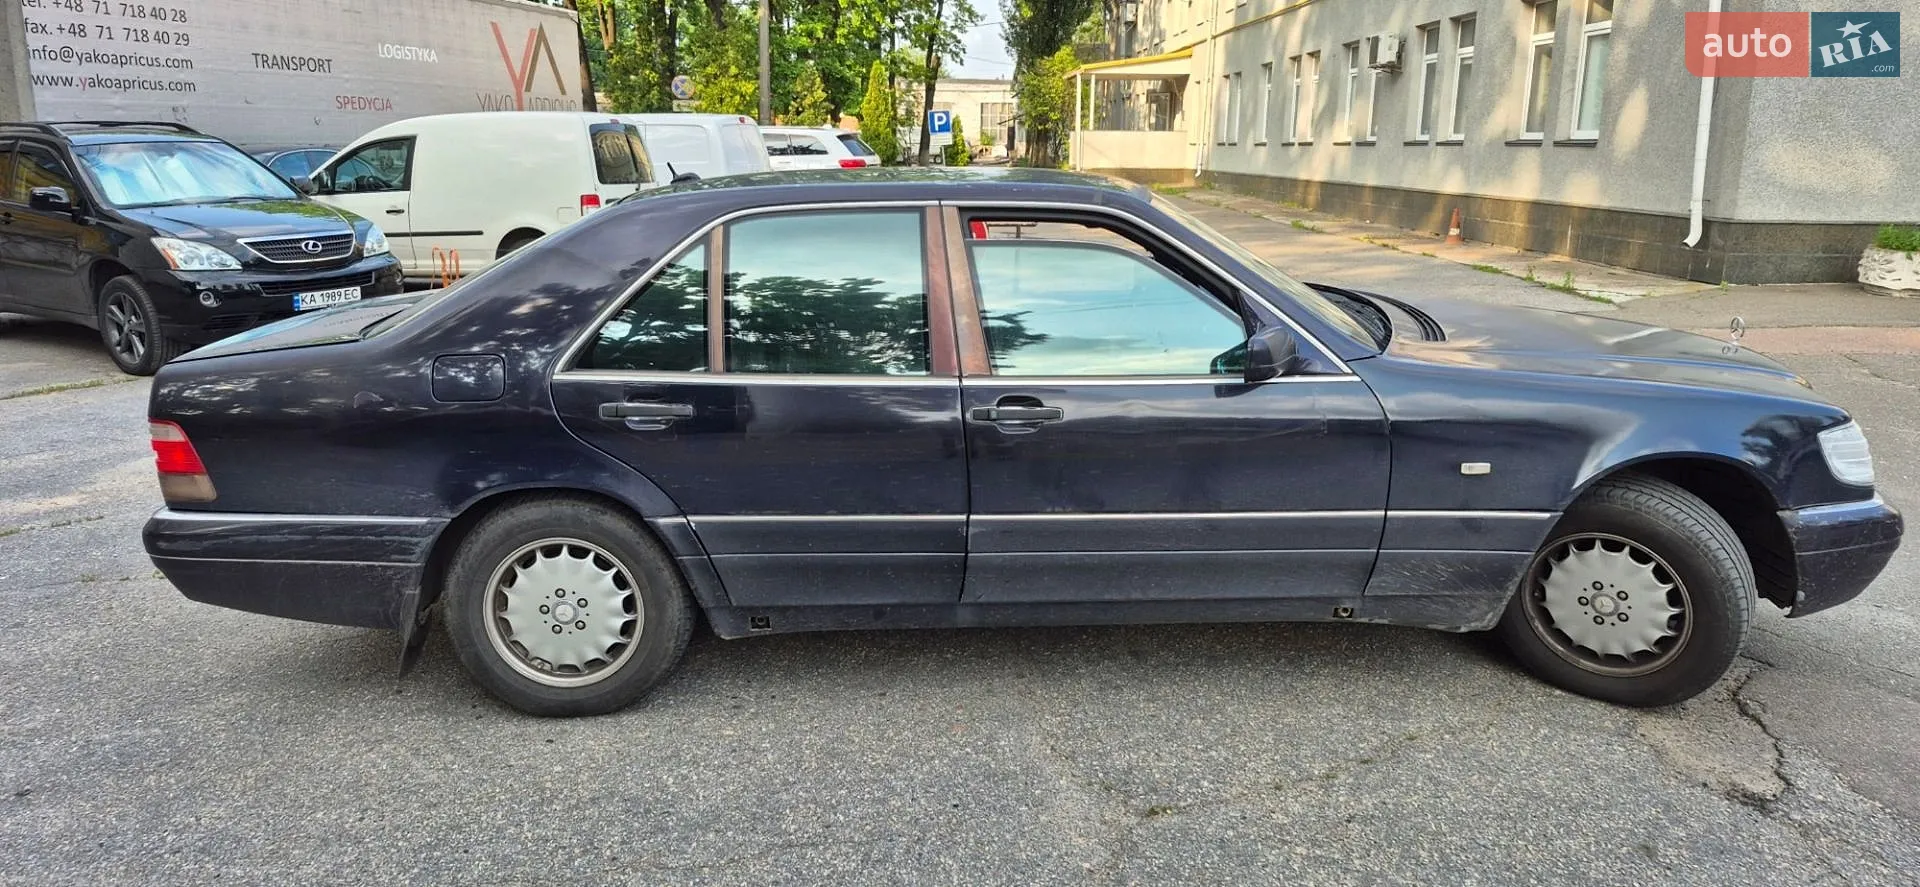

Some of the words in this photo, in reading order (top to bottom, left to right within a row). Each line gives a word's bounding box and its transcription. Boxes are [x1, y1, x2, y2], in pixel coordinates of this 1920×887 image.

[53, 0, 84, 13] +48
[92, 0, 111, 15] 71
[119, 2, 147, 19] 718
[150, 6, 167, 21] 40
[170, 8, 188, 23] 28
[24, 17, 53, 35] fax.
[56, 22, 88, 38] +48
[95, 25, 115, 40] 71
[122, 27, 150, 43] 718
[153, 30, 171, 44] 40
[173, 32, 191, 47] 29
[26, 44, 194, 70] info@yakoapricus.com
[251, 52, 333, 74] TRANSPORT
[377, 42, 439, 63] LOGISTYKA
[31, 73, 197, 93] www.yakoapricus.com
[335, 95, 393, 113] SPEDYCJA
[933, 112, 947, 132] P
[300, 293, 317, 305] KA
[320, 290, 342, 303] 1989
[344, 288, 359, 300] EC
